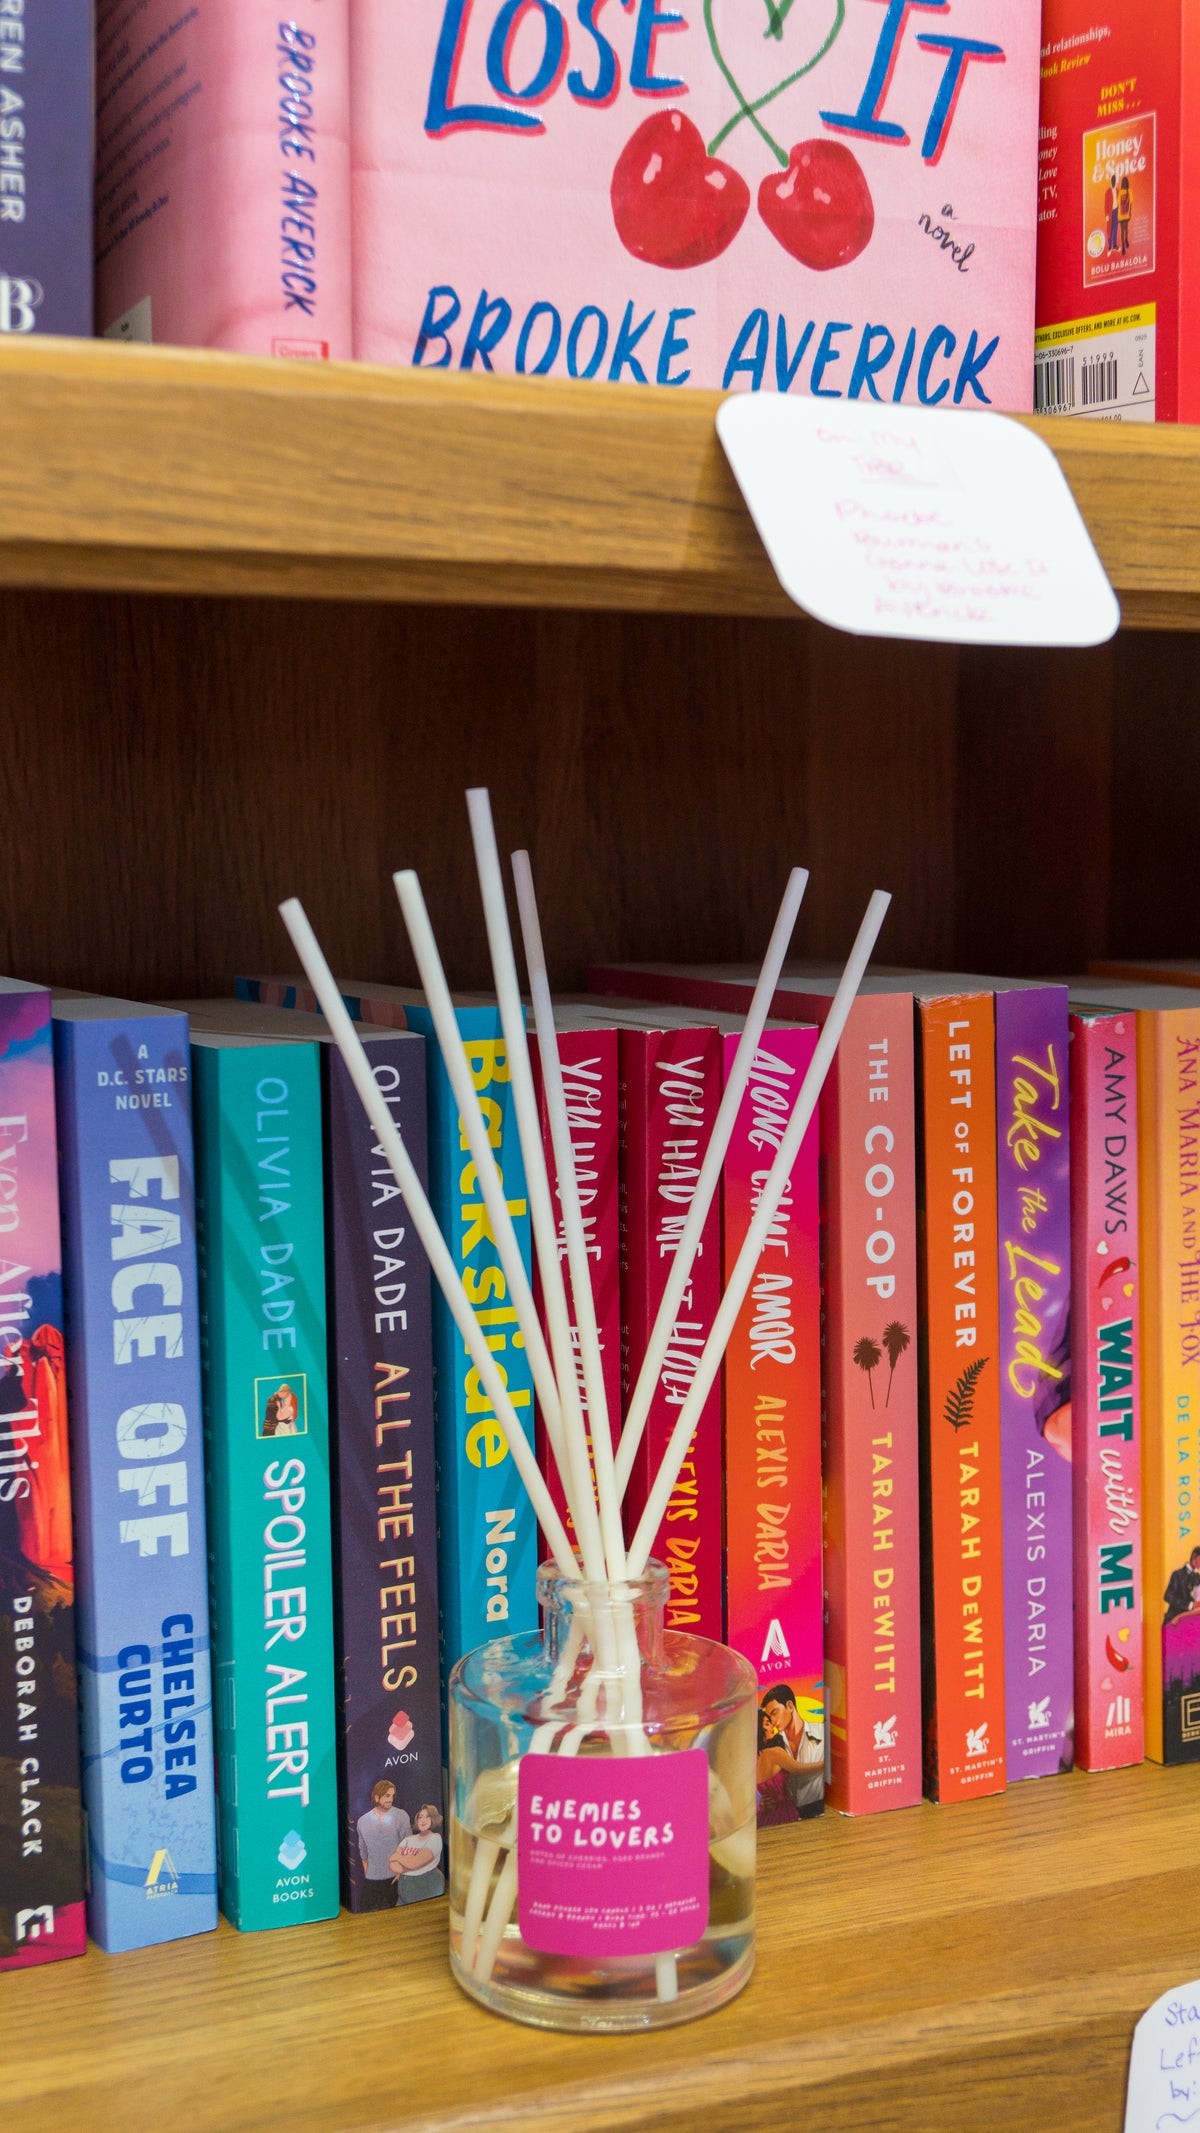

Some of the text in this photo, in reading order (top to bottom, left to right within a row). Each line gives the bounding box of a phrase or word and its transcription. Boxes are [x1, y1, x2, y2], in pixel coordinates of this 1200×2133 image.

[1052, 25, 1111, 55] relationships,
[1060, 54, 1092, 73] Review
[0, 0, 26, 223] REN ASHER
[424, 0, 1006, 166] LOSE IT
[1100, 77, 1136, 100] DON'T
[275, 20, 319, 318] BROOKE AVERICK
[1039, 166, 1058, 181] Love
[1096, 135, 1143, 162] Honey
[1105, 155, 1147, 186] Spice
[917, 211, 976, 273] novel
[940, 203, 957, 221] a
[1091, 264, 1110, 276] BOLU
[412, 285, 1001, 406] BROOKE AVERICK
[1052, 328, 1075, 339] EXCLUSIVE
[1093, 322, 1103, 330] AND
[1103, 319, 1116, 328] MORE
[97, 1067, 189, 1087] D.C. STARS
[137, 1044, 149, 1060] A
[868, 1038, 889, 1103] THE
[948, 1021, 972, 1109] LEFT
[1176, 1034, 1200, 1092] ANA
[115, 1092, 173, 1110] NOVEL
[954, 1121, 970, 1154] OF
[1104, 1046, 1128, 1235] AMY DAWS
[657, 1139, 701, 1204] HAD
[255, 1077, 297, 1351] OLIVIA DADE
[864, 1125, 896, 1300] CO-OP
[1181, 1205, 1197, 1250] AND
[373, 1227, 408, 1334] DADE
[952, 1166, 977, 1348] FOREVER
[1177, 1250, 1200, 1304] THE
[748, 1273, 796, 1371] AMOR
[108, 1154, 190, 1558] FACE OFF
[1004, 1043, 1064, 1677] Take the Lead ALEXIS DARIA
[374, 1361, 411, 1448] ALL
[0, 1396, 41, 1502] This
[753, 1395, 789, 1488] ALEXIS
[1097, 1316, 1139, 1615] WAIT with ME
[1177, 1395, 1192, 1539] DE LA ROSA
[376, 1450, 414, 1543] THE
[872, 1432, 894, 1551] TARAH
[959, 1441, 982, 1560] TARAH
[485, 1508, 517, 1623] Nora
[753, 1502, 793, 1591] DARIA
[664, 1537, 702, 1627] DARIA
[263, 1458, 310, 1808] SPOILER ALERT
[379, 1555, 418, 1692] FEELS
[759, 1660, 792, 1673] AVON
[13, 1595, 43, 1858] DEBORAH CLACK
[117, 1644, 154, 1784] CURTO
[161, 1613, 198, 1800] CHELSEA
[1104, 1727, 1132, 1739] MIRA
[384, 1751, 419, 1768] AVON
[878, 1755, 891, 1763] ST.
[950, 1757, 1004, 1775] ST. MARTIN'S
[1012, 1730, 1066, 1747] ST. MARTIN'S
[1022, 1744, 1056, 1756] GRIFFIN
[864, 1764, 906, 1777] MARTIN'S
[867, 1777, 903, 1790] GRIFFIN
[960, 1771, 994, 1785] GRIFFIN
[530, 1795, 642, 1824] ENEMIES
[530, 1822, 675, 1849] TO LOVERS
[146, 1882, 179, 1894] ATRIA
[272, 1887, 315, 1904] BOOKS
[275, 1874, 310, 1888] AVON
[1160, 2037, 1200, 2071] Lef
